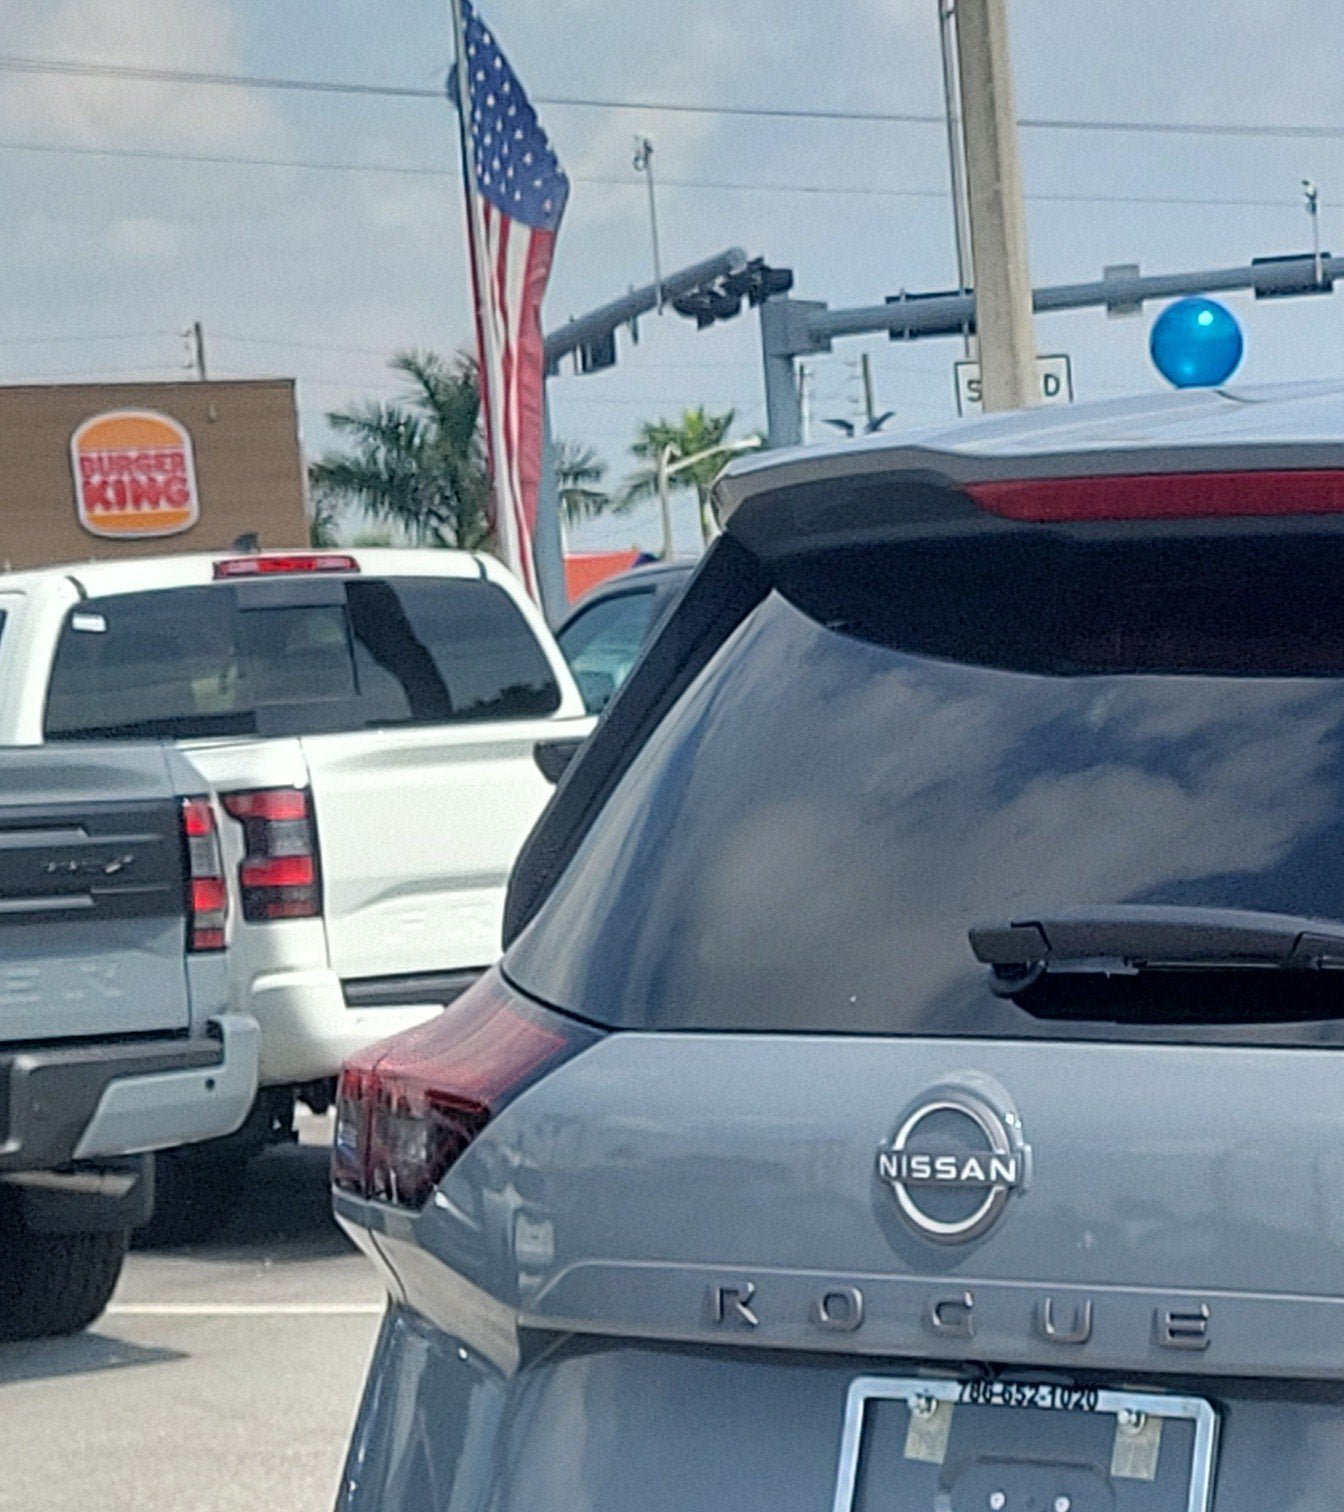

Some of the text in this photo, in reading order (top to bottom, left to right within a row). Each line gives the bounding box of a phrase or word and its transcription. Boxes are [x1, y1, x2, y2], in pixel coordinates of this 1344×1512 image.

[80, 452, 186, 477] BURGER
[83, 477, 190, 511] KING
[879, 1152, 1017, 1184] NISSAN
[711, 1281, 1212, 1351] ROGUE
